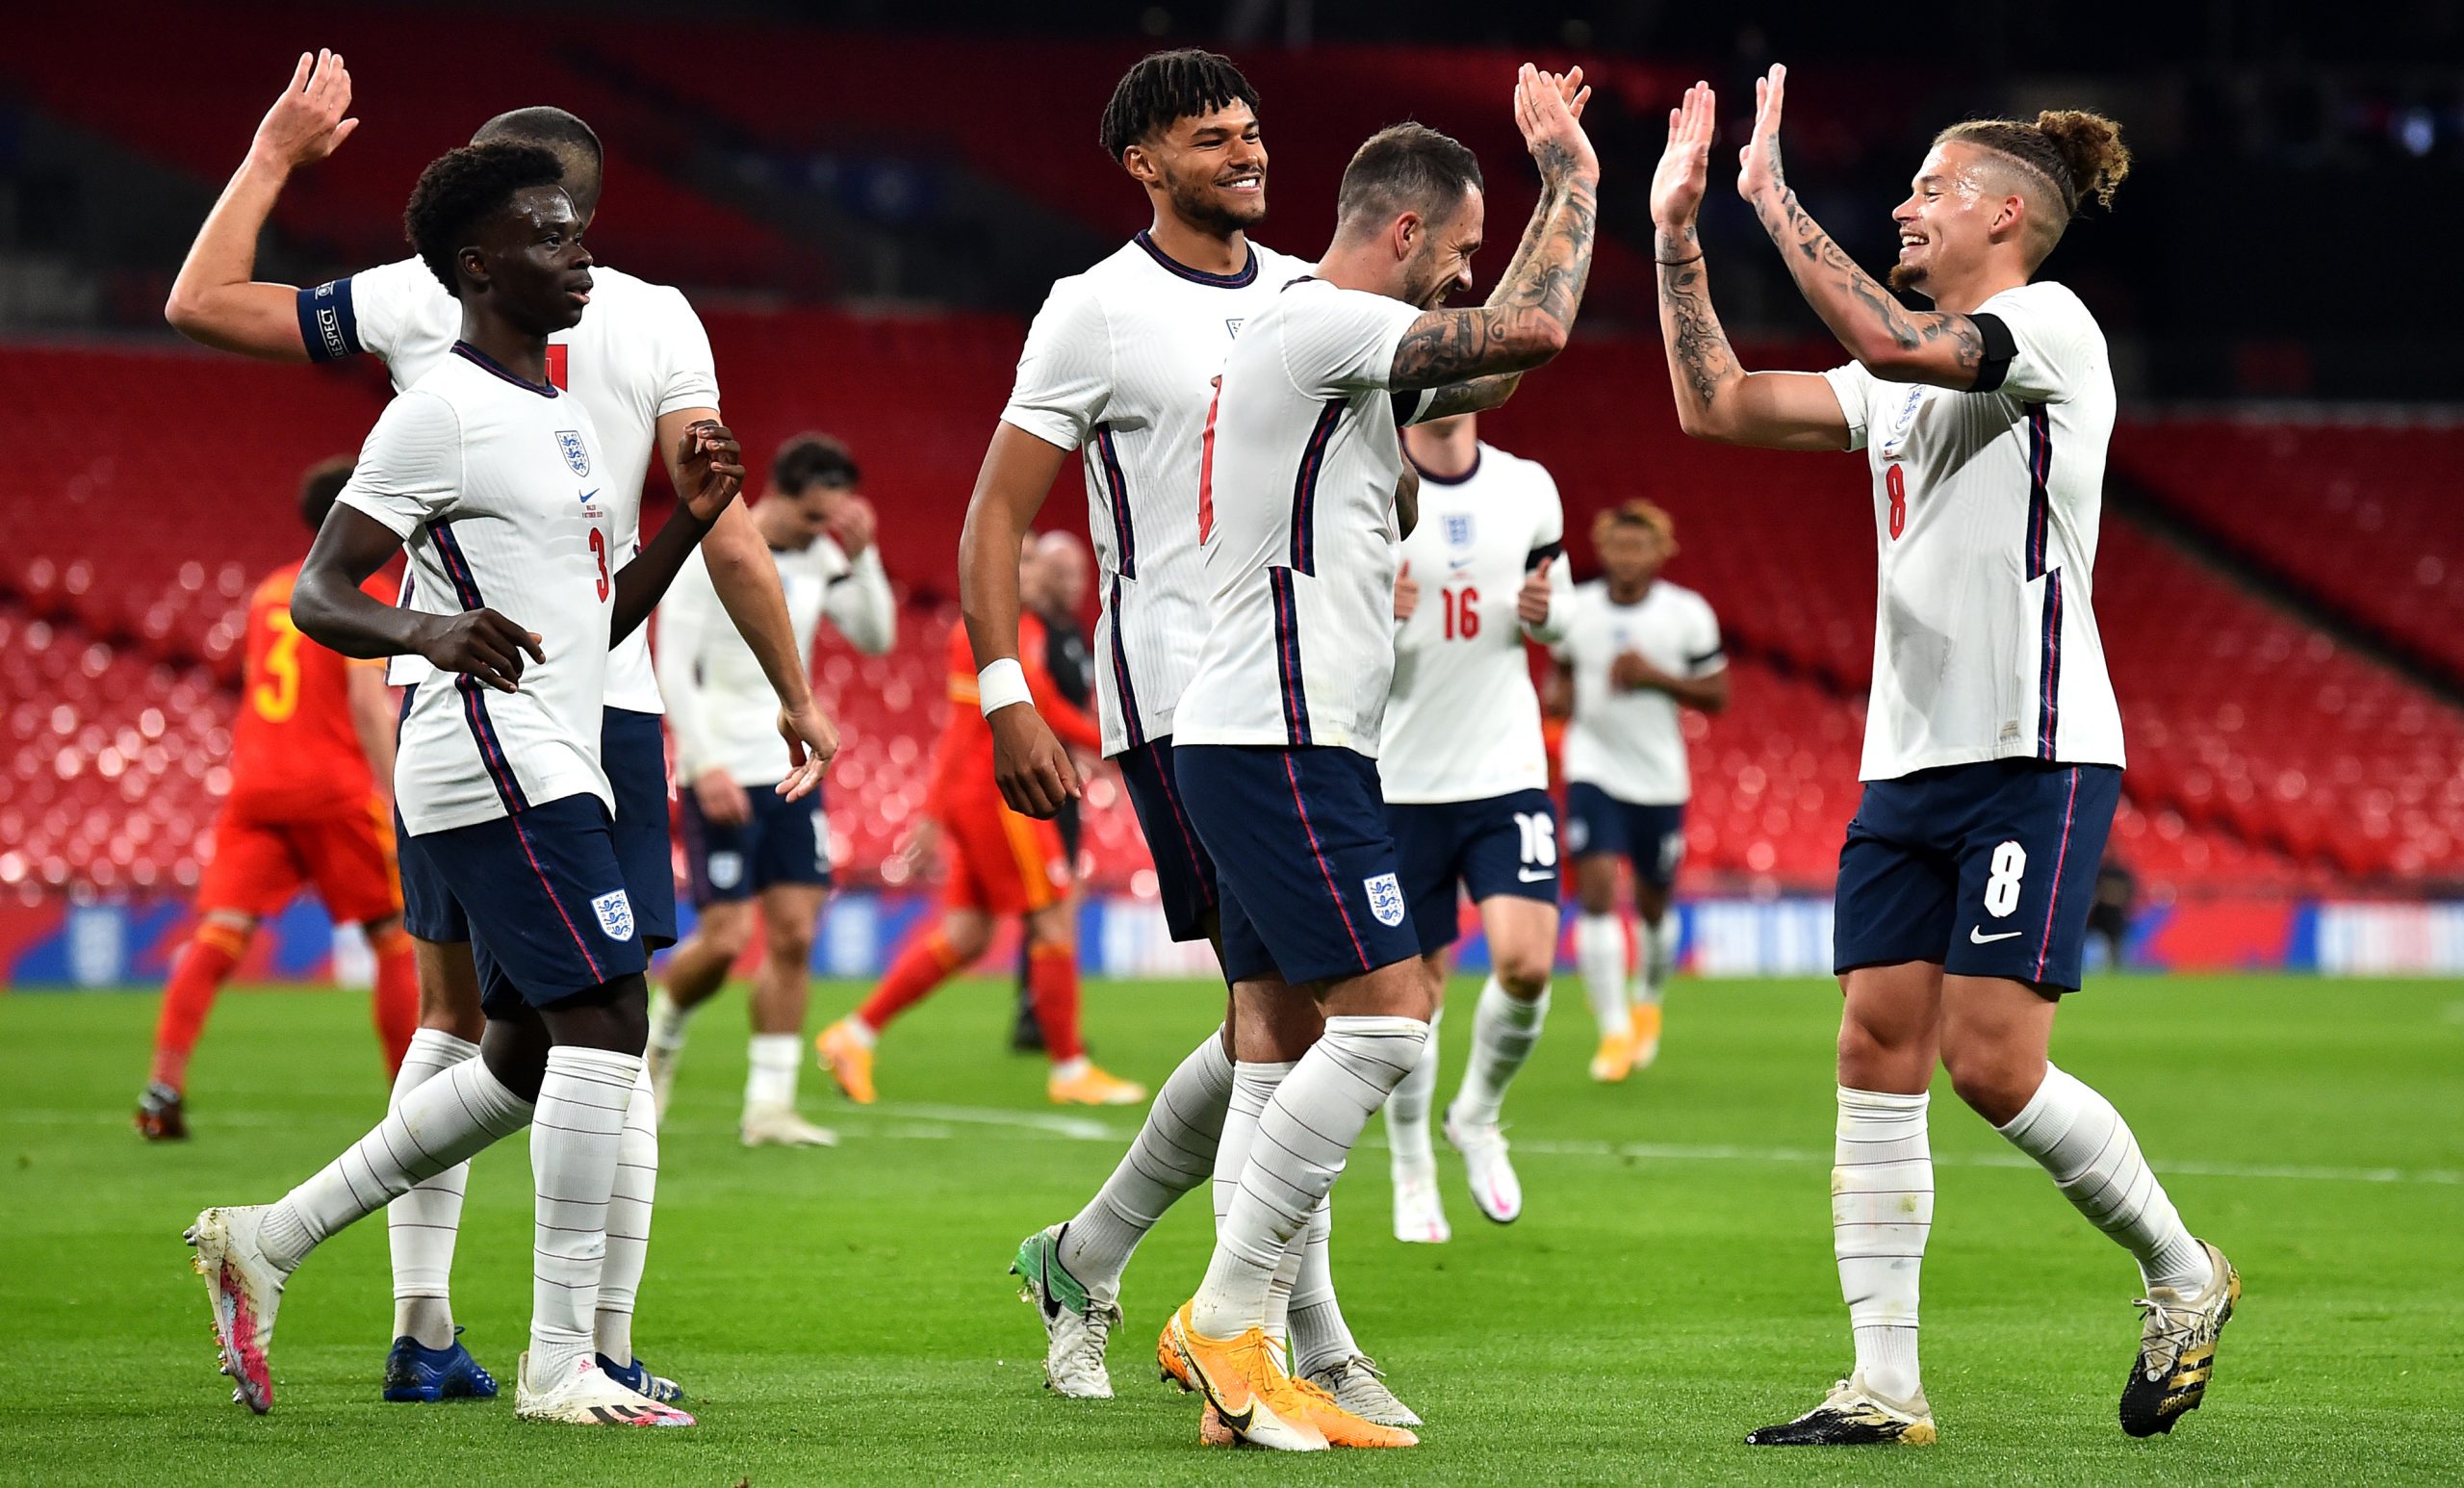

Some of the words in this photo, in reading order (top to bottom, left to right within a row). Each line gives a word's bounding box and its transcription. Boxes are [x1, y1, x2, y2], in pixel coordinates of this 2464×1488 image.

[321, 308, 346, 359] RESPECT
[1886, 463, 1907, 542] 8
[588, 526, 610, 603] 3
[1441, 586, 1479, 641] 16
[253, 608, 300, 723] 3
[1513, 810, 1556, 866] 16
[1984, 840, 2027, 918] 8
